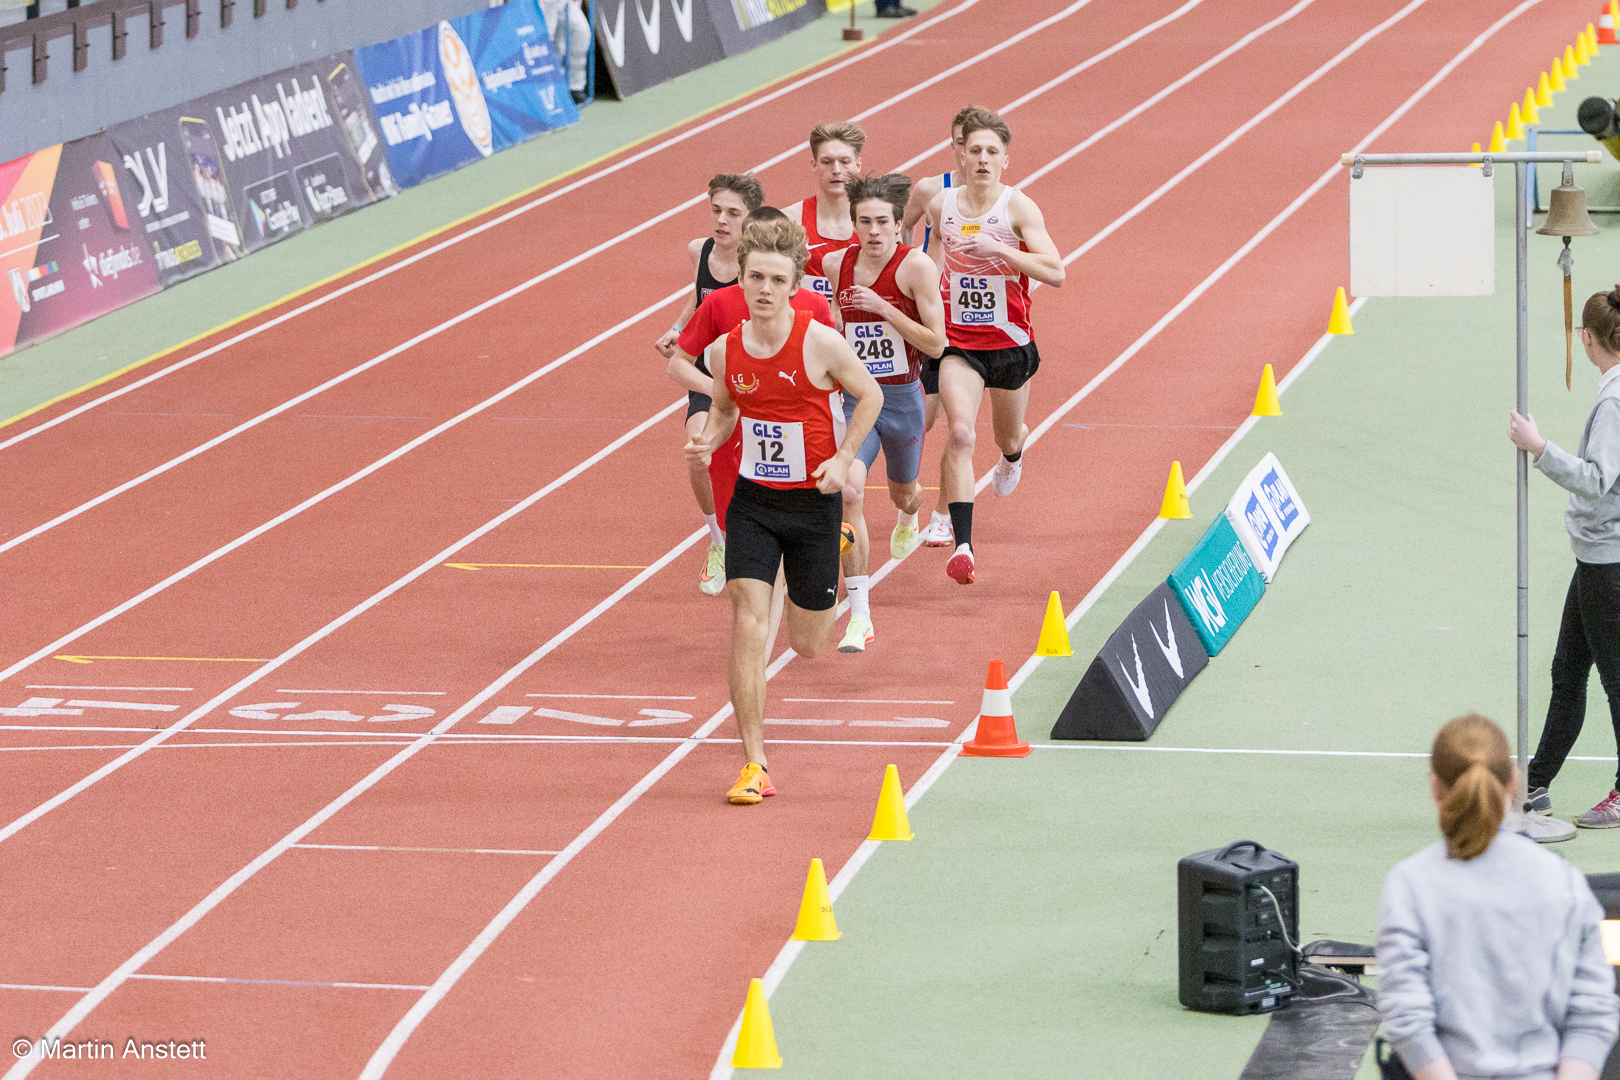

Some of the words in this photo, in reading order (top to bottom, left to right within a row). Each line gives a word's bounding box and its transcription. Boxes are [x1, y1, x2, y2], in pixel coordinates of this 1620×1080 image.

[216, 101, 263, 162] Jetzt
[251, 94, 292, 158] App
[276, 74, 334, 138] laden!
[813, 279, 833, 292] GL
[958, 291, 996, 310] 493
[854, 339, 895, 361] 248
[872, 362, 893, 371] PLAN
[758, 439, 785, 462] 12
[768, 466, 789, 474] PLAN
[1184, 567, 1229, 637] WGV
[1211, 540, 1252, 602] VERSICHERUNG
